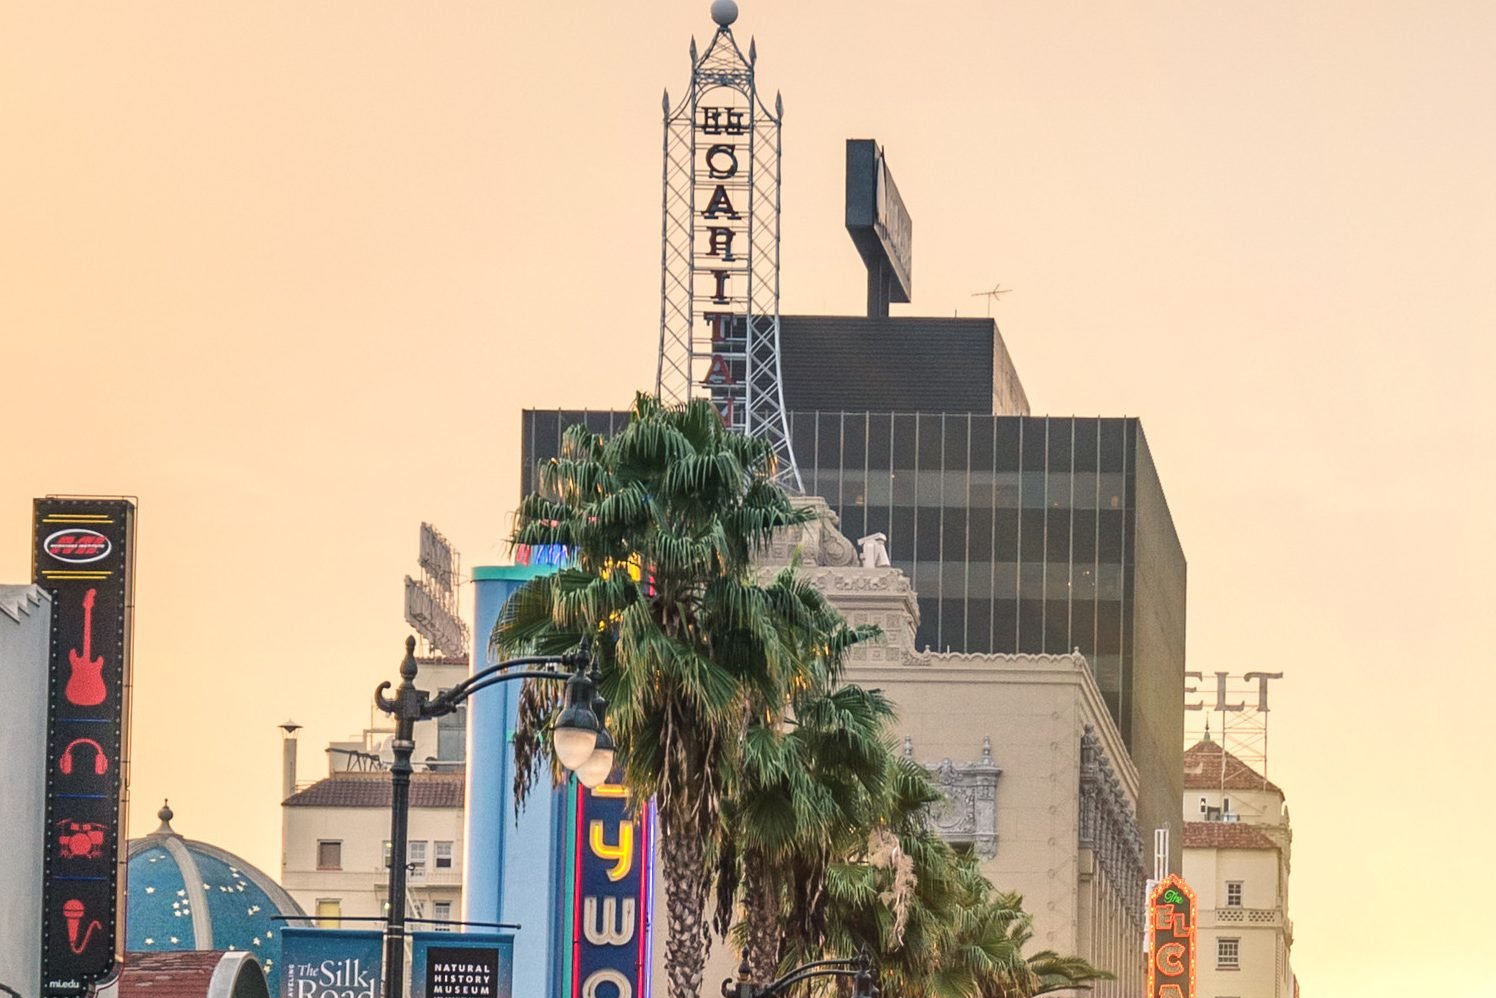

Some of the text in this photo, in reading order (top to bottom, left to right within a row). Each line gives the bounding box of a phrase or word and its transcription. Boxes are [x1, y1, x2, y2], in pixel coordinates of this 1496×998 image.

[1155, 903, 1191, 938] EL
[299, 957, 369, 988] The Silk
[434, 963, 490, 974] NATURAL
[434, 974, 490, 984] HISTORY
[433, 985, 490, 995] MUSEUM
